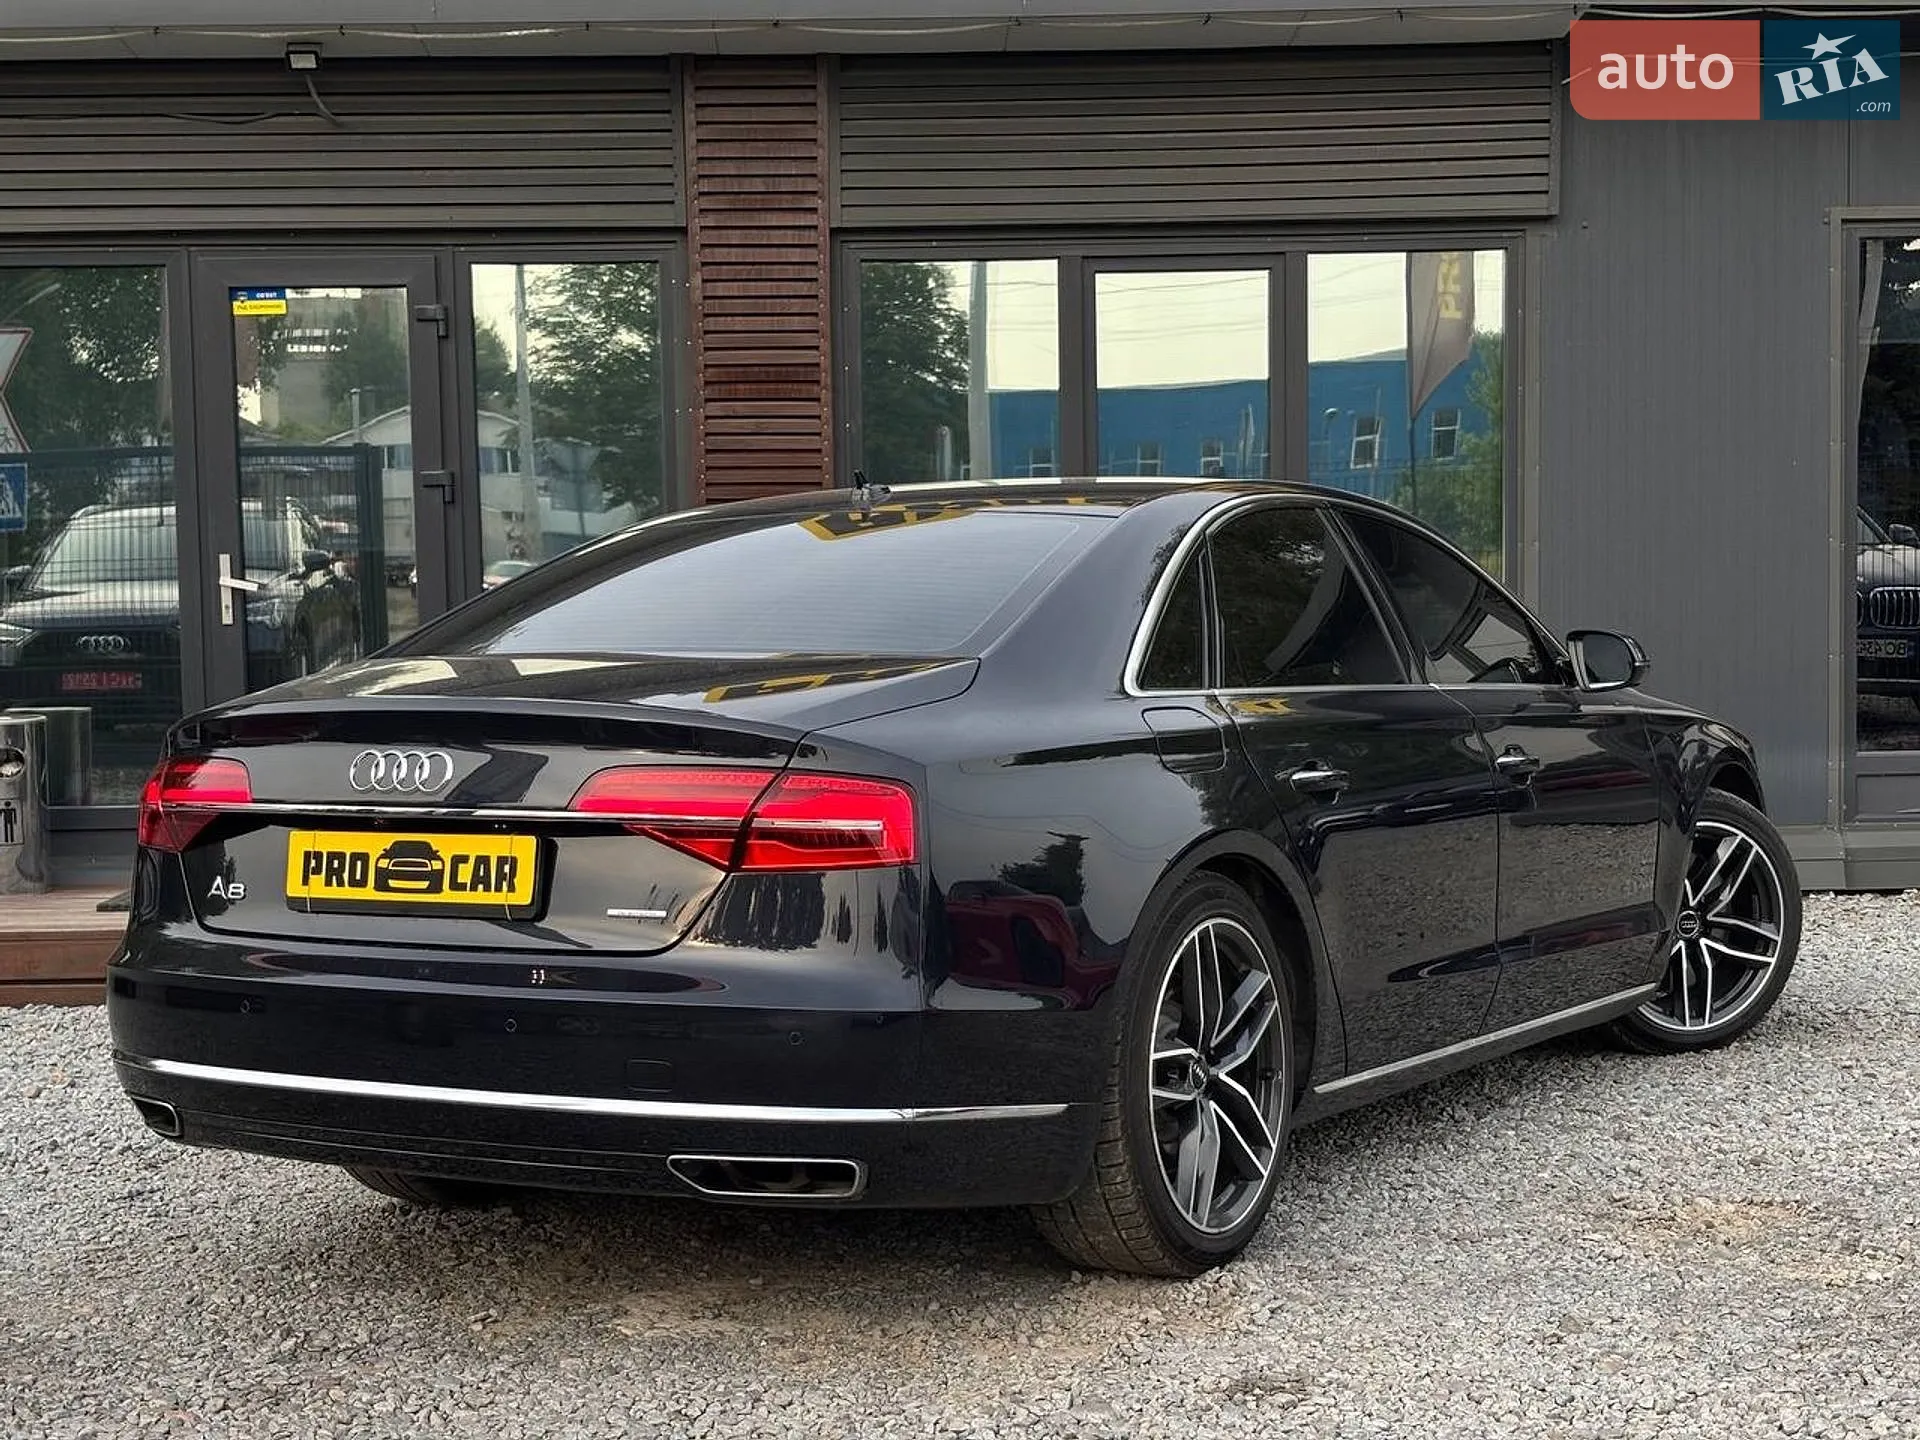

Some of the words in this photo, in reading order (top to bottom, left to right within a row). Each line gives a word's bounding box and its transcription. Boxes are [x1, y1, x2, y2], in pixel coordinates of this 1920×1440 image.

[207, 875, 246, 900] A8
[301, 850, 371, 888] PRO
[448, 854, 518, 894] CAR
